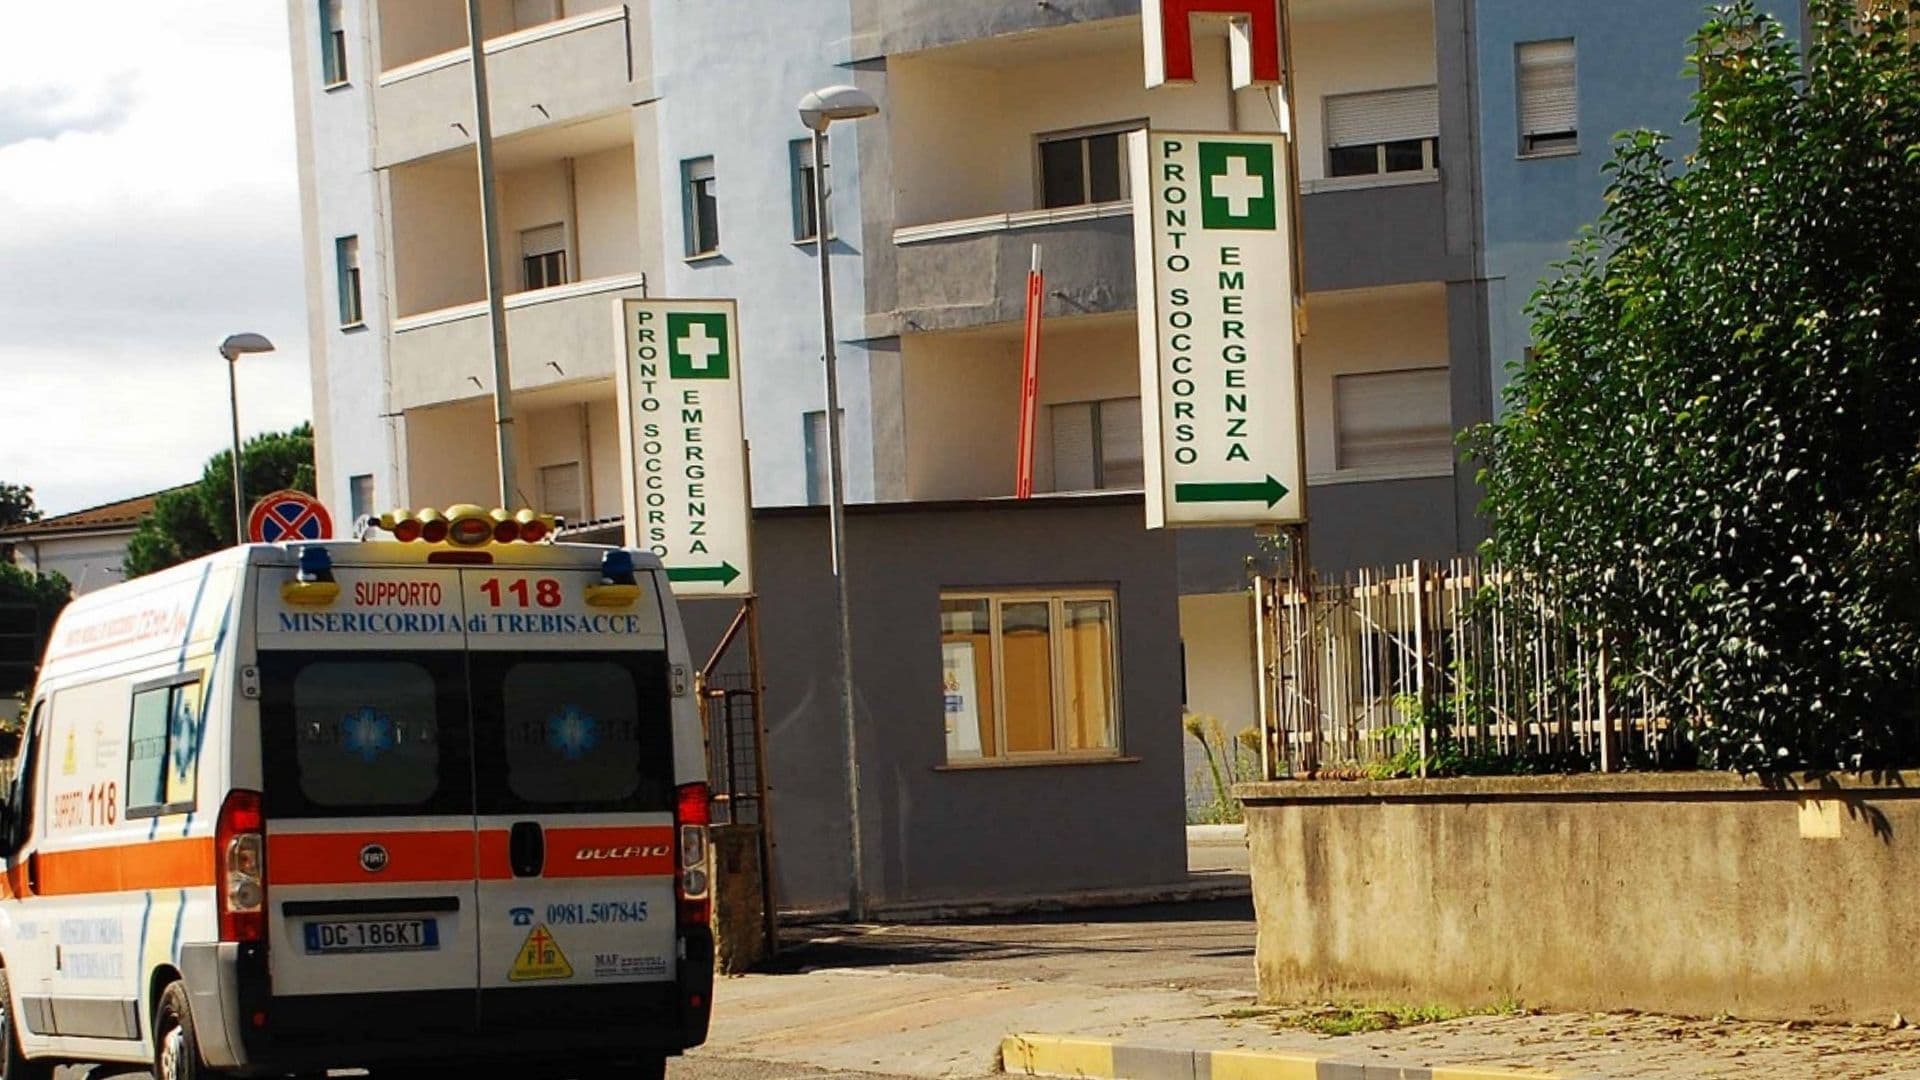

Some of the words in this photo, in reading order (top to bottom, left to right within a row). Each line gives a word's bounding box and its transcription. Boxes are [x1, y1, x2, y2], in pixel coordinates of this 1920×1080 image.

[1164, 141, 1189, 272] PRONTO
[638, 312, 661, 412] PRONTO
[1169, 288, 1198, 465] SOCCORSO
[1218, 247, 1250, 461] EMERGENZA
[643, 423, 668, 558] SOCCORSO
[682, 390, 708, 554] EMERGENZA
[279, 612, 462, 633] MISERICORDIA
[468, 613, 486, 633] di
[492, 613, 640, 633] TREBISACCE
[355, 582, 441, 606] SUPPORTO
[480, 578, 562, 608] 118
[87, 781, 117, 826] 118
[575, 845, 670, 860] DUCATO
[320, 924, 348, 946] DG
[357, 921, 422, 945] 186KT
[547, 902, 648, 925] 0981.507845
